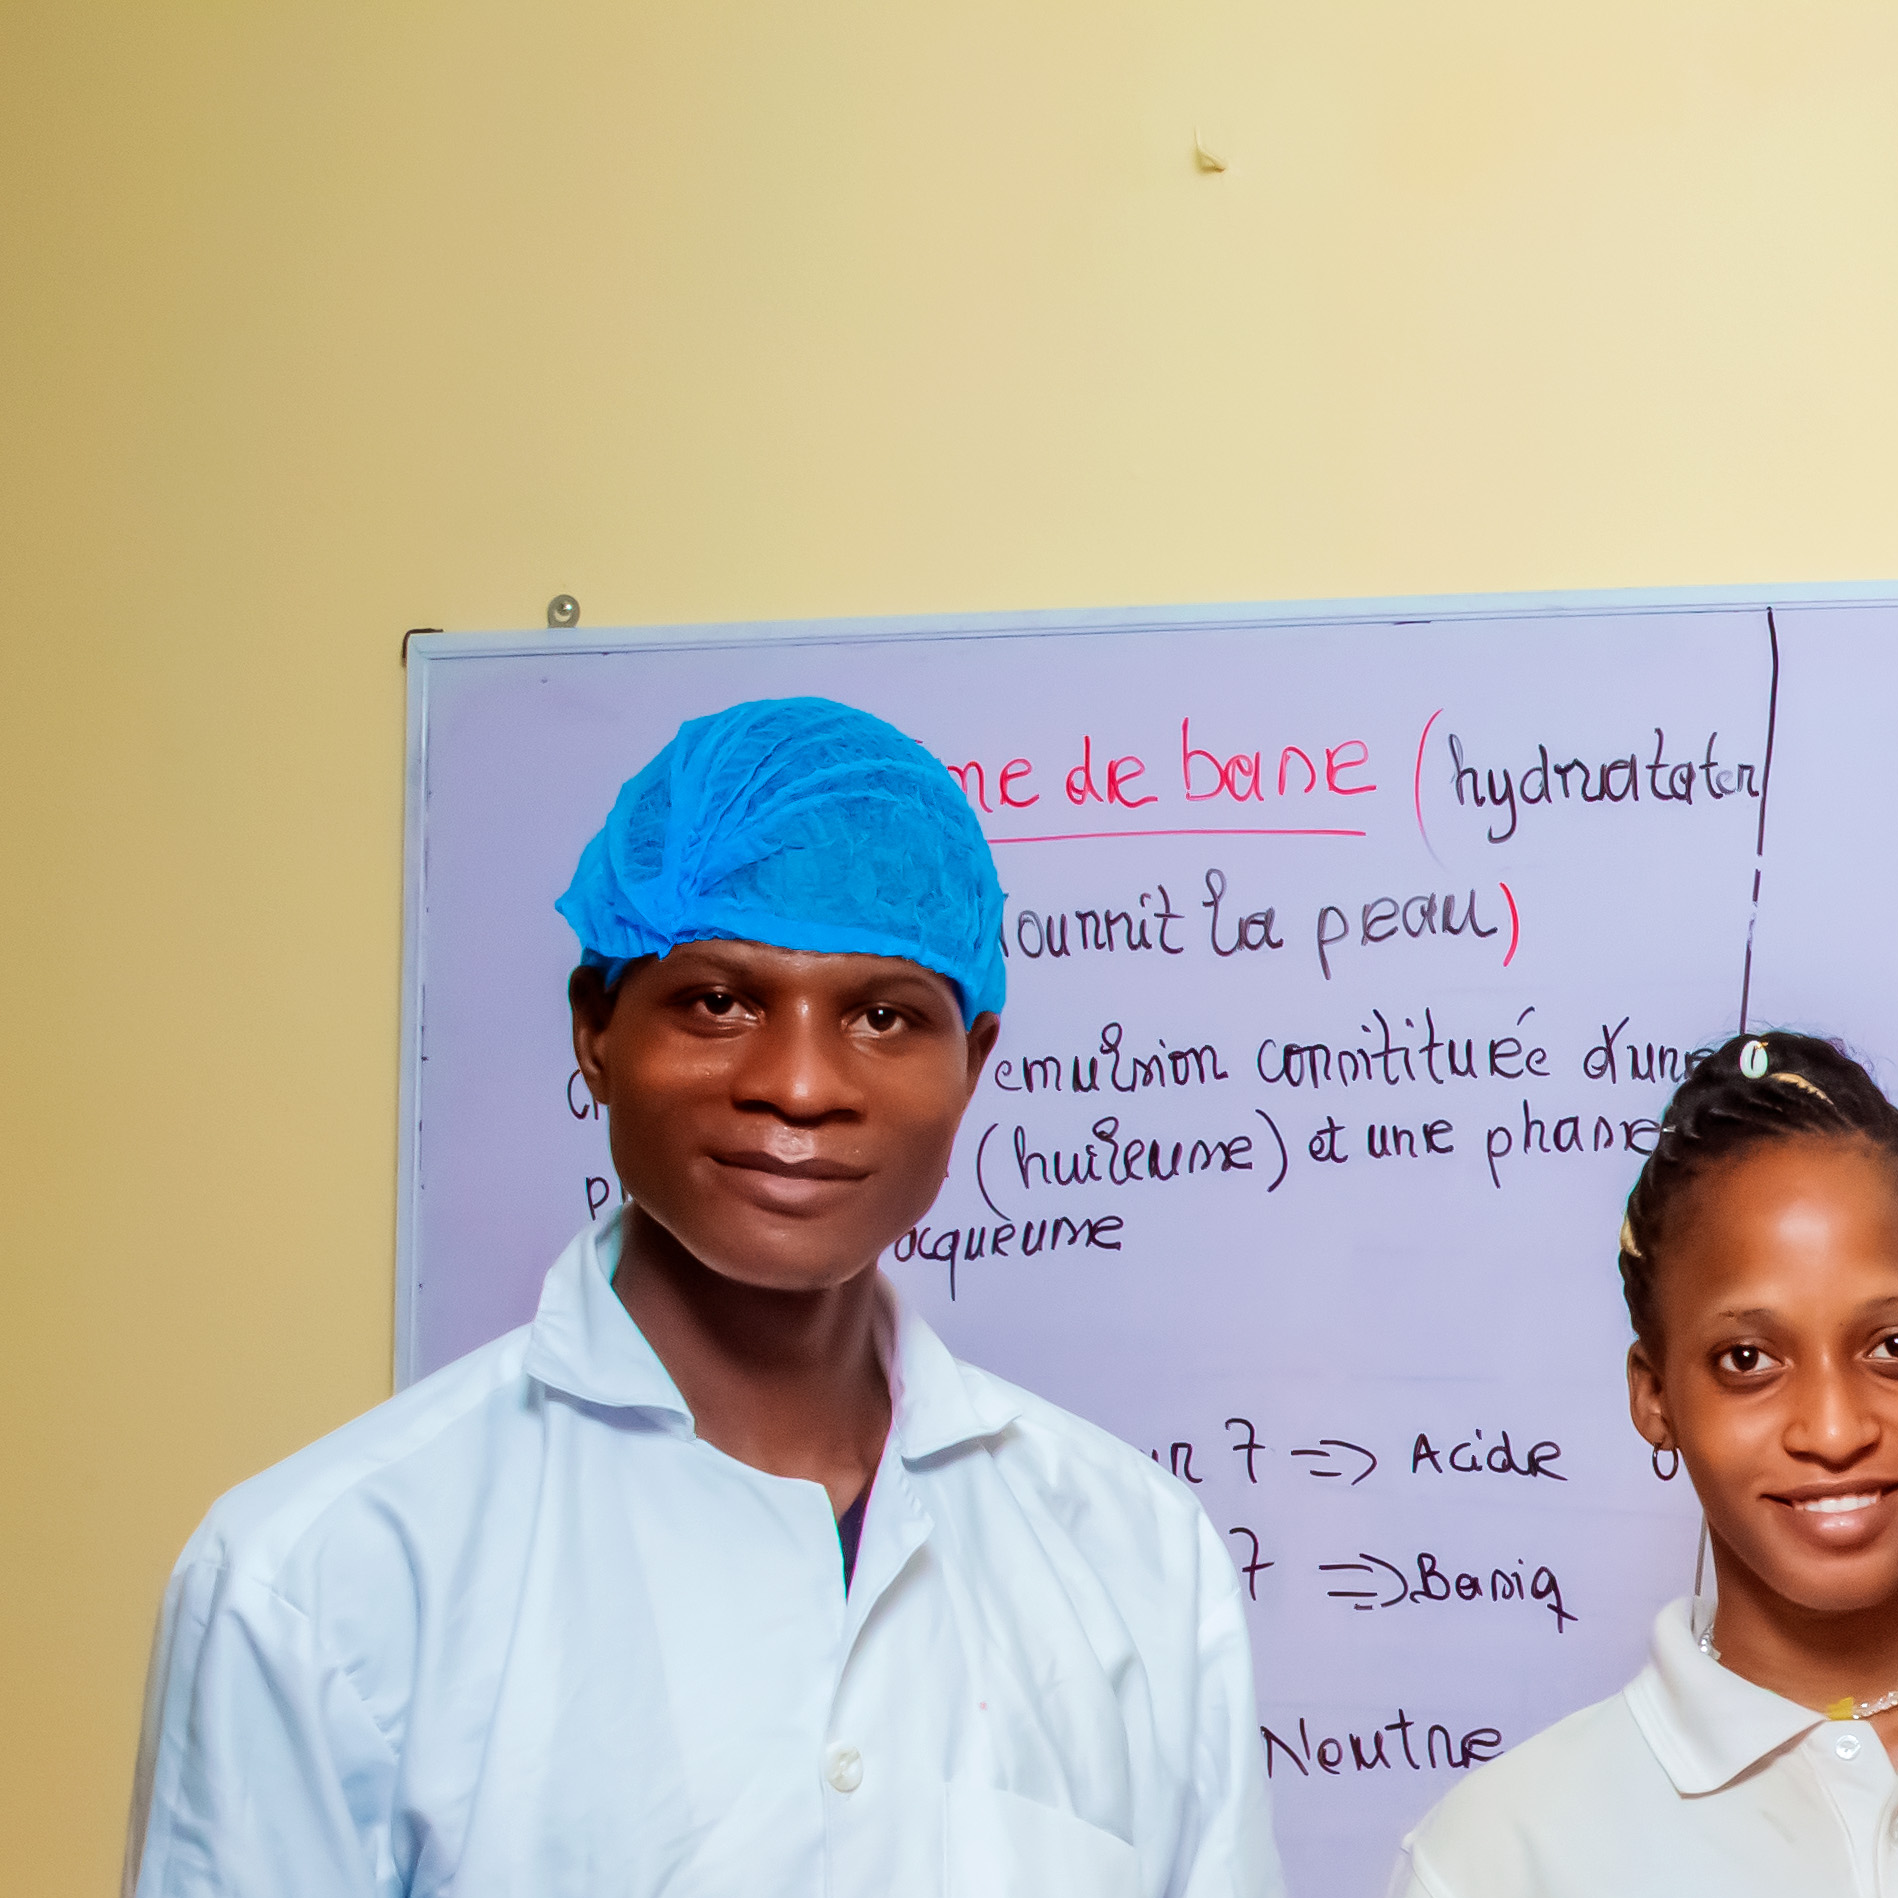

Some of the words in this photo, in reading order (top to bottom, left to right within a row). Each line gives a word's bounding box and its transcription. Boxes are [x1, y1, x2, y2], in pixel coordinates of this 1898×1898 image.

[1065, 735, 1159, 809] de
[1204, 868, 1284, 957] la
[1308, 1115, 1350, 1163] et
[1368, 1118, 1454, 1159] une
[1486, 1099, 1661, 1190] phase
[1223, 1417, 1267, 1485] 7
[1411, 1426, 1569, 1483] Acide
[1228, 1525, 1276, 1603] 7
[1260, 1706, 1507, 1780] Neutre
